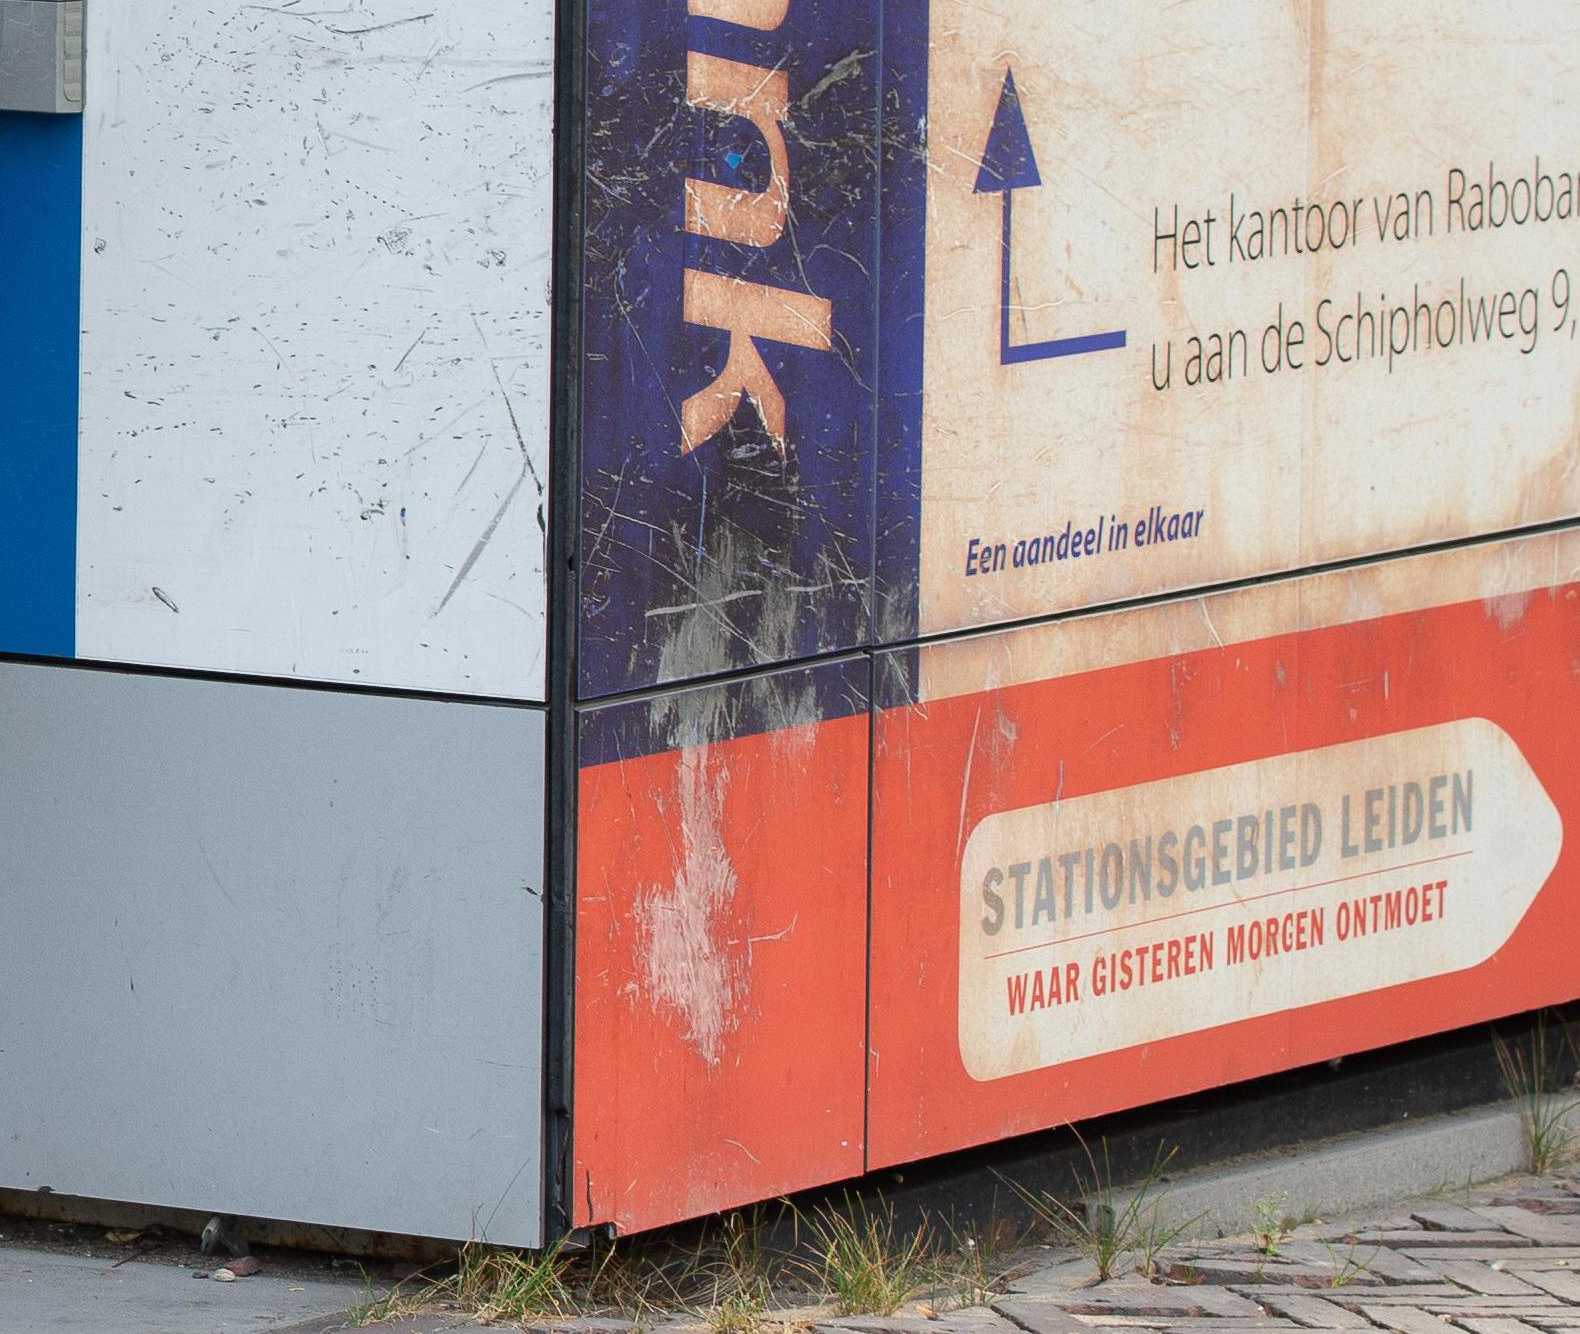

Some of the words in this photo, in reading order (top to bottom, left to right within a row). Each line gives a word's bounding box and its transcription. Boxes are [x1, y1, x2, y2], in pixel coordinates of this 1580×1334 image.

[1153, 203, 1217, 274] Het
[1229, 192, 1364, 263] kantoor
[1374, 189, 1434, 243] van
[1447, 154, 1580, 234] Raboba
[1151, 339, 1173, 392] u
[1184, 329, 1248, 387] aan
[1261, 301, 1306, 374] de
[1314, 275, 1539, 374] Schipholweg
[1551, 268, 1577, 341] 9,
[965, 537, 1007, 577] Een
[1012, 514, 1105, 568] aandeel
[1107, 513, 1129, 553] in
[1134, 505, 1205, 548] elkaar
[981, 800, 1323, 938] STATIONSGEBIED
[1341, 768, 1474, 860] LEIDEN
[1006, 961, 1081, 1017] WAAR
[1091, 930, 1215, 998] GISTEREN
[1226, 906, 1325, 967] MORGEN
[1335, 879, 1449, 942] ONTMOET
